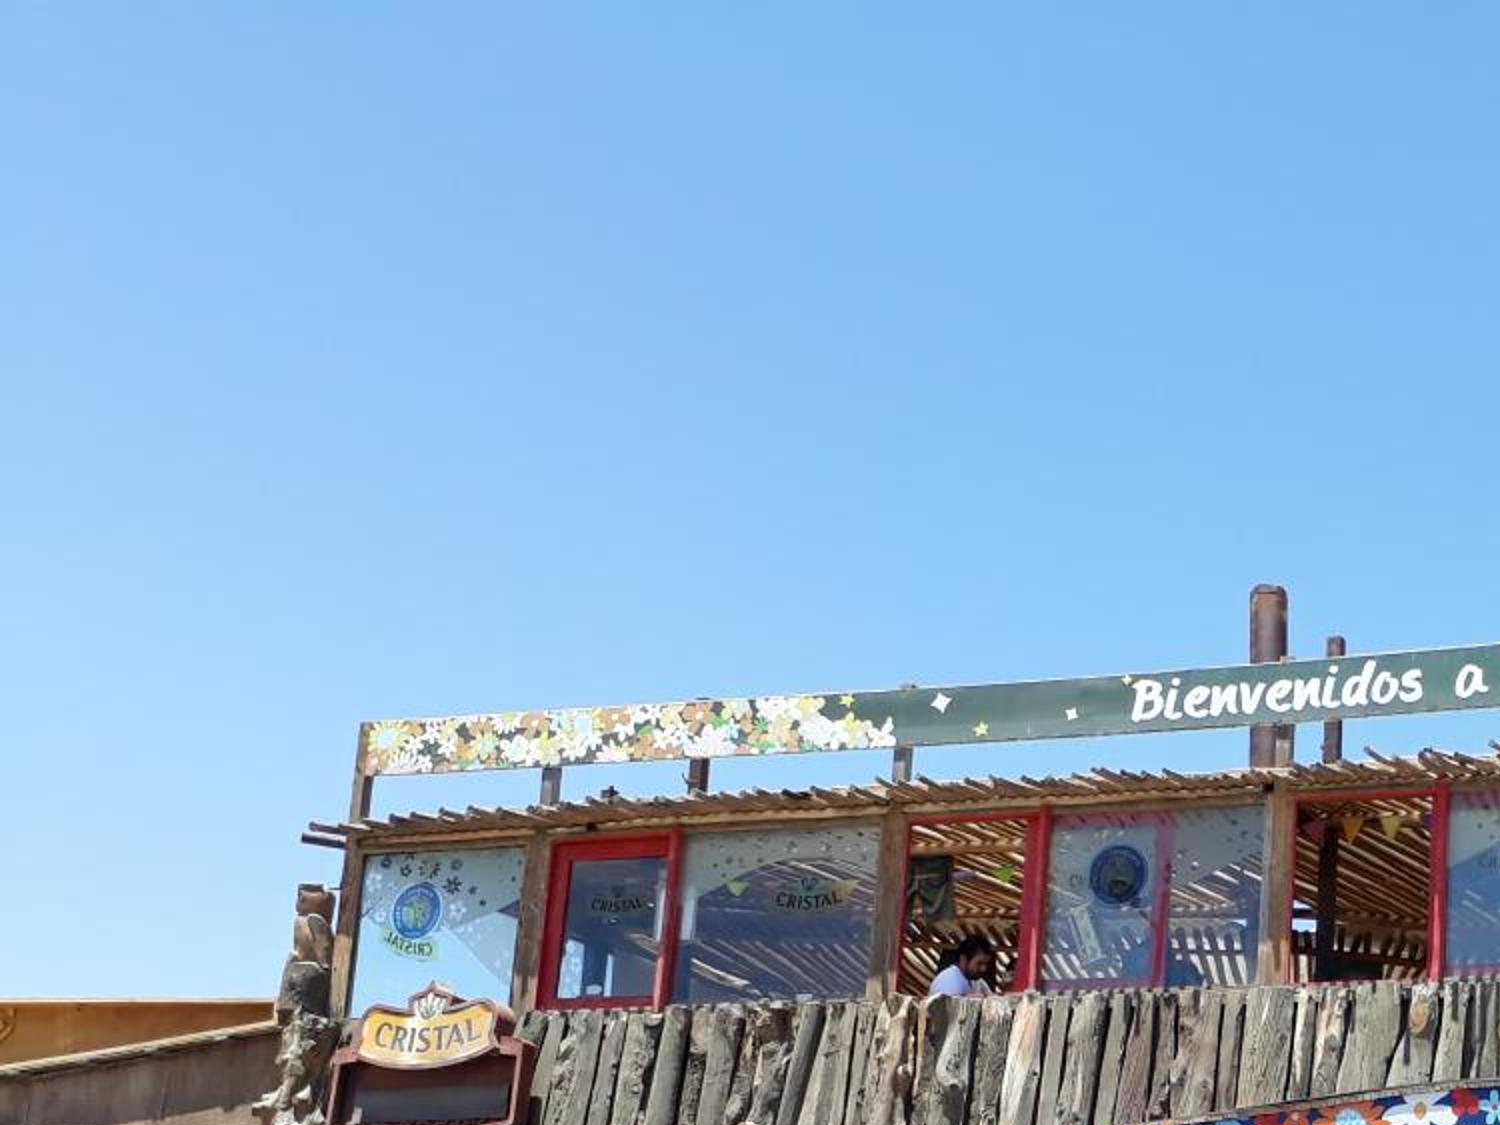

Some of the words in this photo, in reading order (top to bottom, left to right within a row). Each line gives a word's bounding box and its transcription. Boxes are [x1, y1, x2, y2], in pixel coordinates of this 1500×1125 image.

[1131, 660, 1424, 722] Bienvenidos
[1455, 663, 1489, 698] a
[775, 890, 842, 911] CRISTAL
[374, 1018, 482, 1054] CRISTAL
